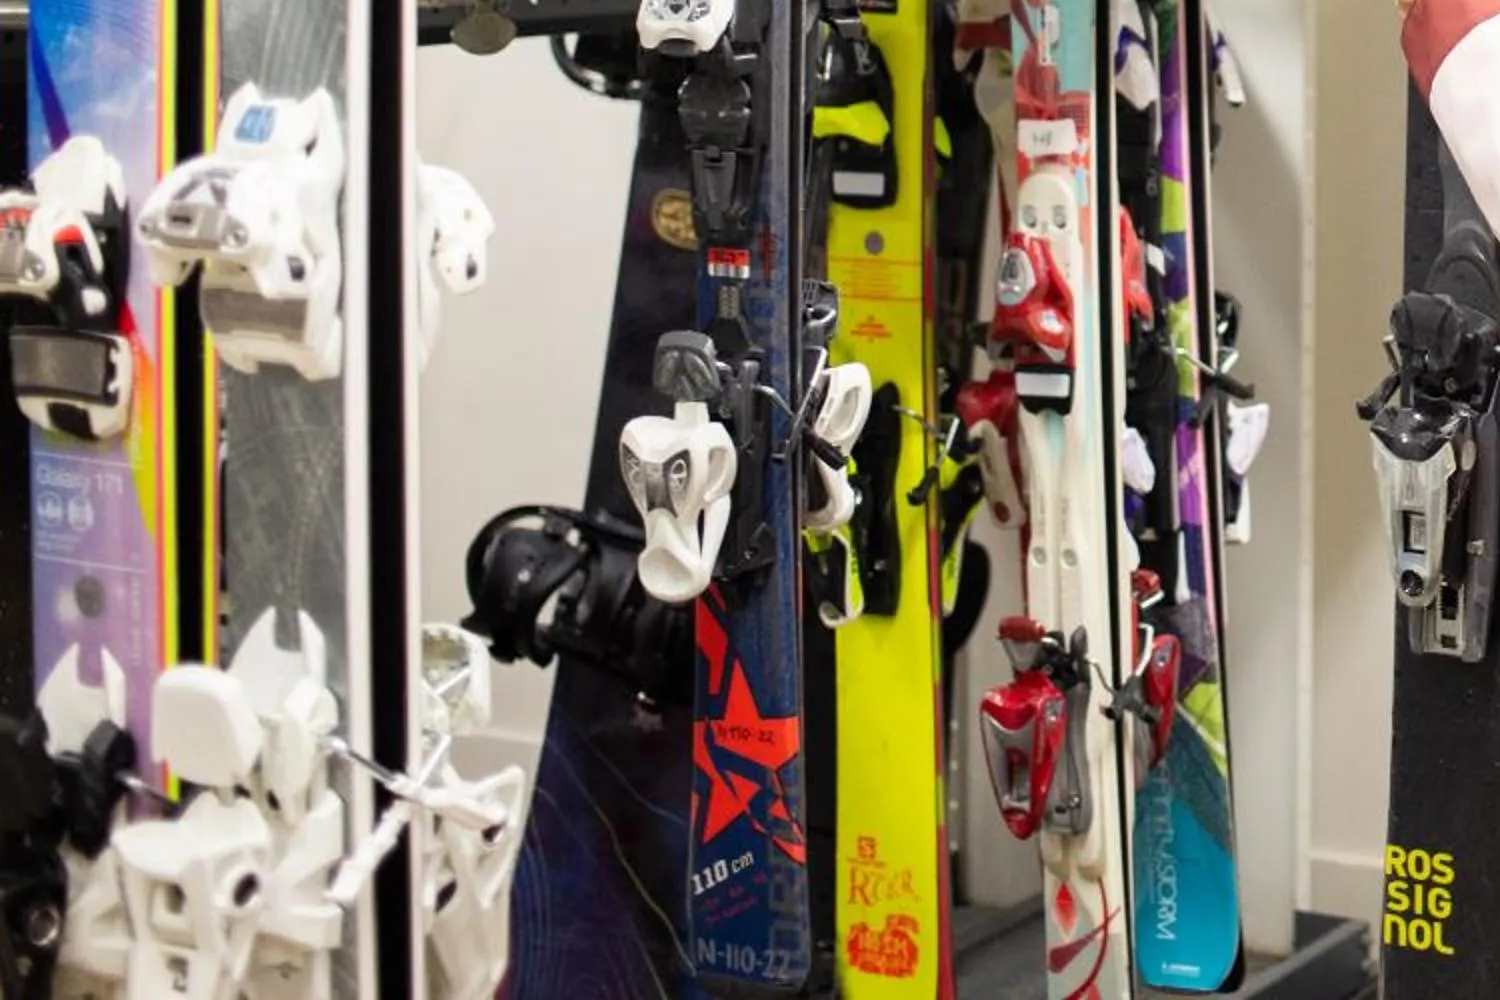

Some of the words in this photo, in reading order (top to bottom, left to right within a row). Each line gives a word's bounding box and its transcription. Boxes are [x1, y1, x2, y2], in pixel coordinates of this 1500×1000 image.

[691, 858, 729, 896] 110
[731, 851, 756, 874] cm
[1384, 844, 1456, 886] ROS
[1386, 880, 1454, 920] SIG
